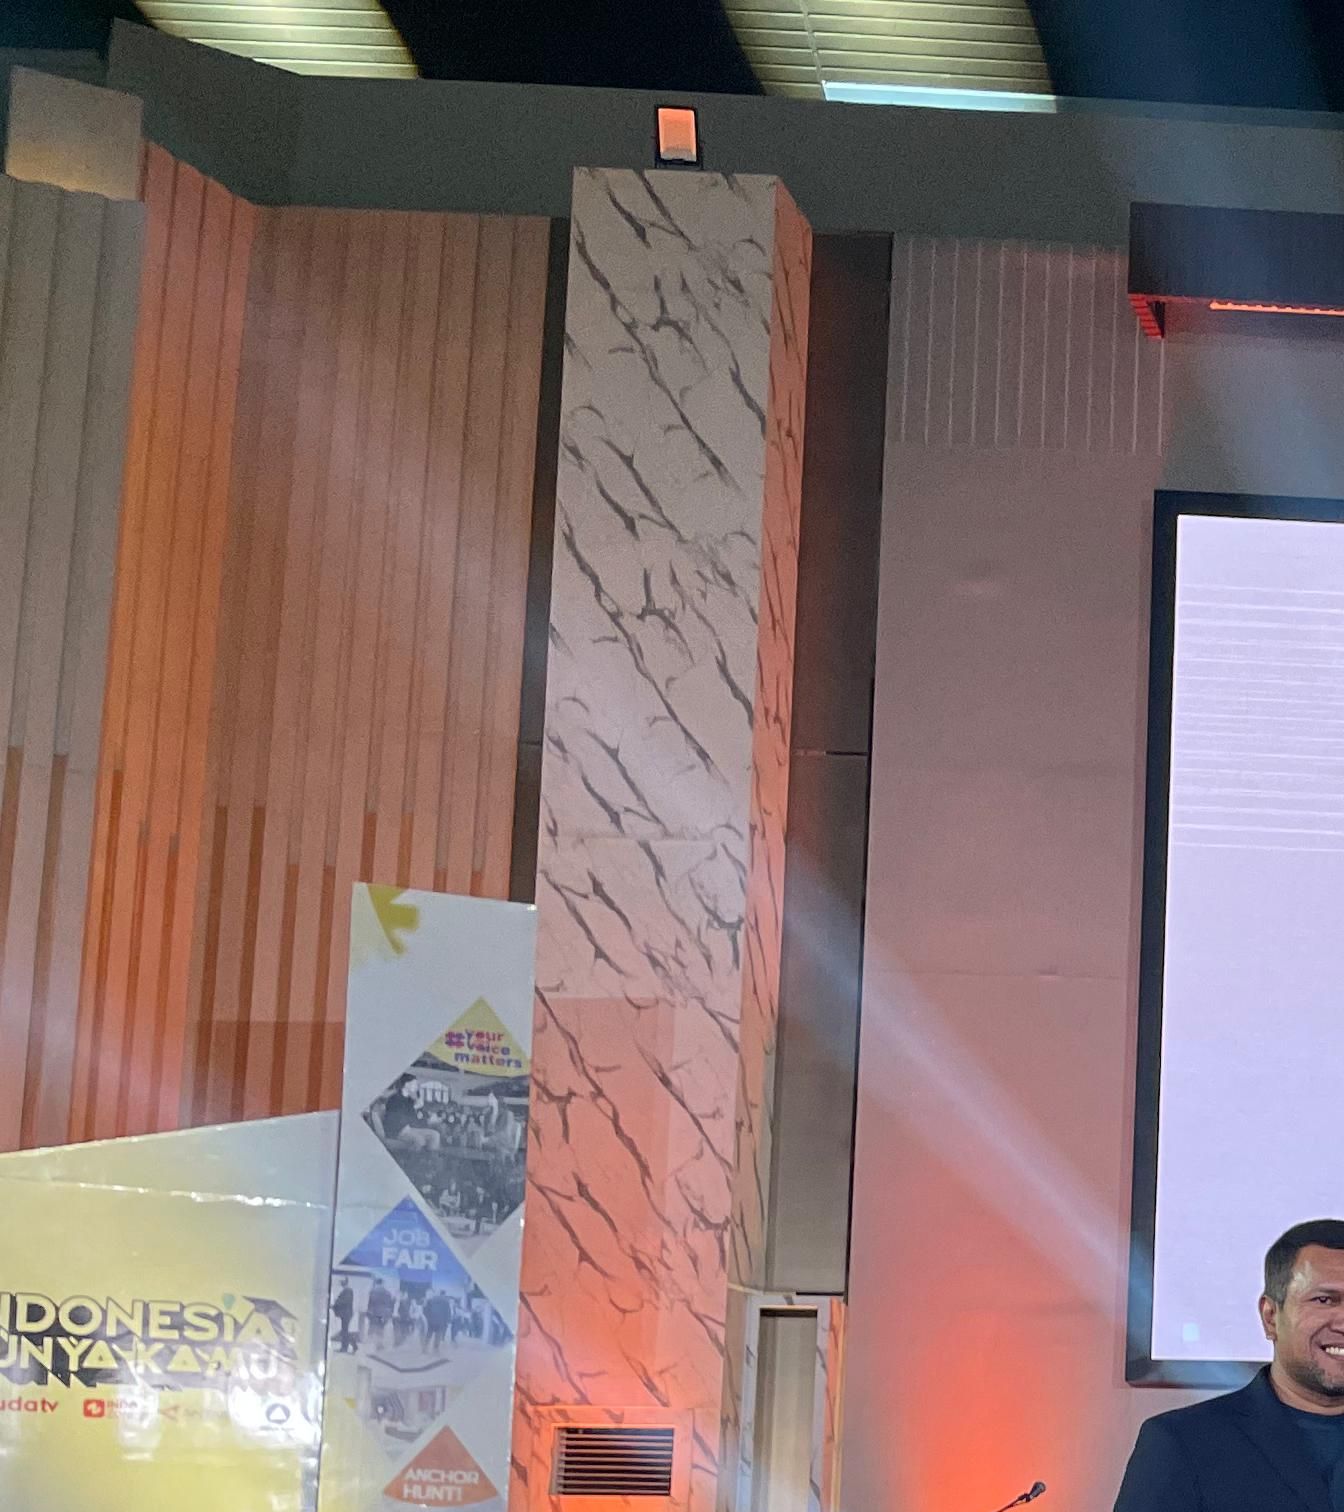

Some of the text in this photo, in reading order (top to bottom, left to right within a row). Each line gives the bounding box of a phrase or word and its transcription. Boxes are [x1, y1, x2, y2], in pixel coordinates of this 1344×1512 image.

[454, 1052, 522, 1069] matters
[383, 1228, 431, 1248] JOB
[381, 1247, 439, 1271] FAIR
[403, 1468, 480, 1485] ANCHOR
[402, 1484, 463, 1502] HUNT!
